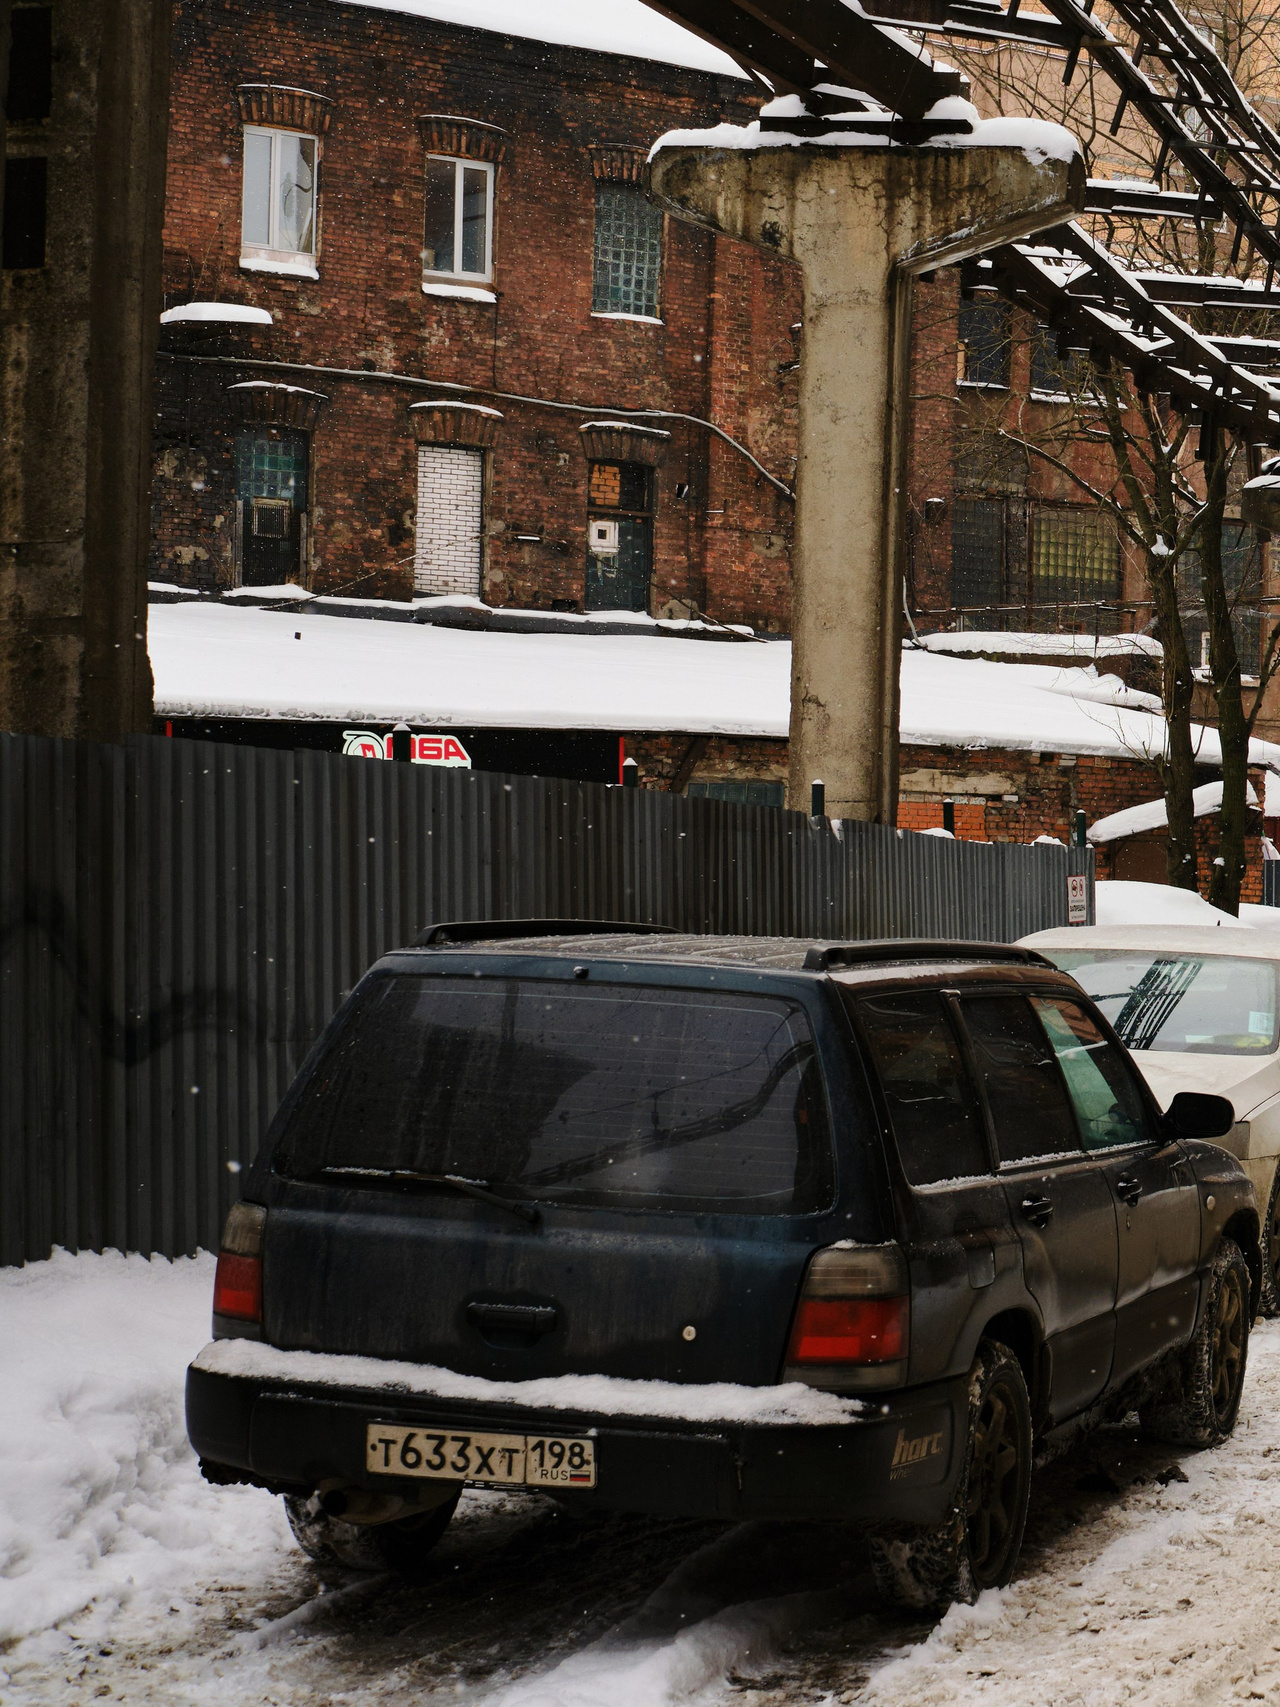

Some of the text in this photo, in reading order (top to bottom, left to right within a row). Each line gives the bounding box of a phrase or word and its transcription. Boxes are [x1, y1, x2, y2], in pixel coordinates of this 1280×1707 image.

[378, 1433, 586, 1477] Т633ХТ 198
[541, 1468, 568, 1481] RUS
